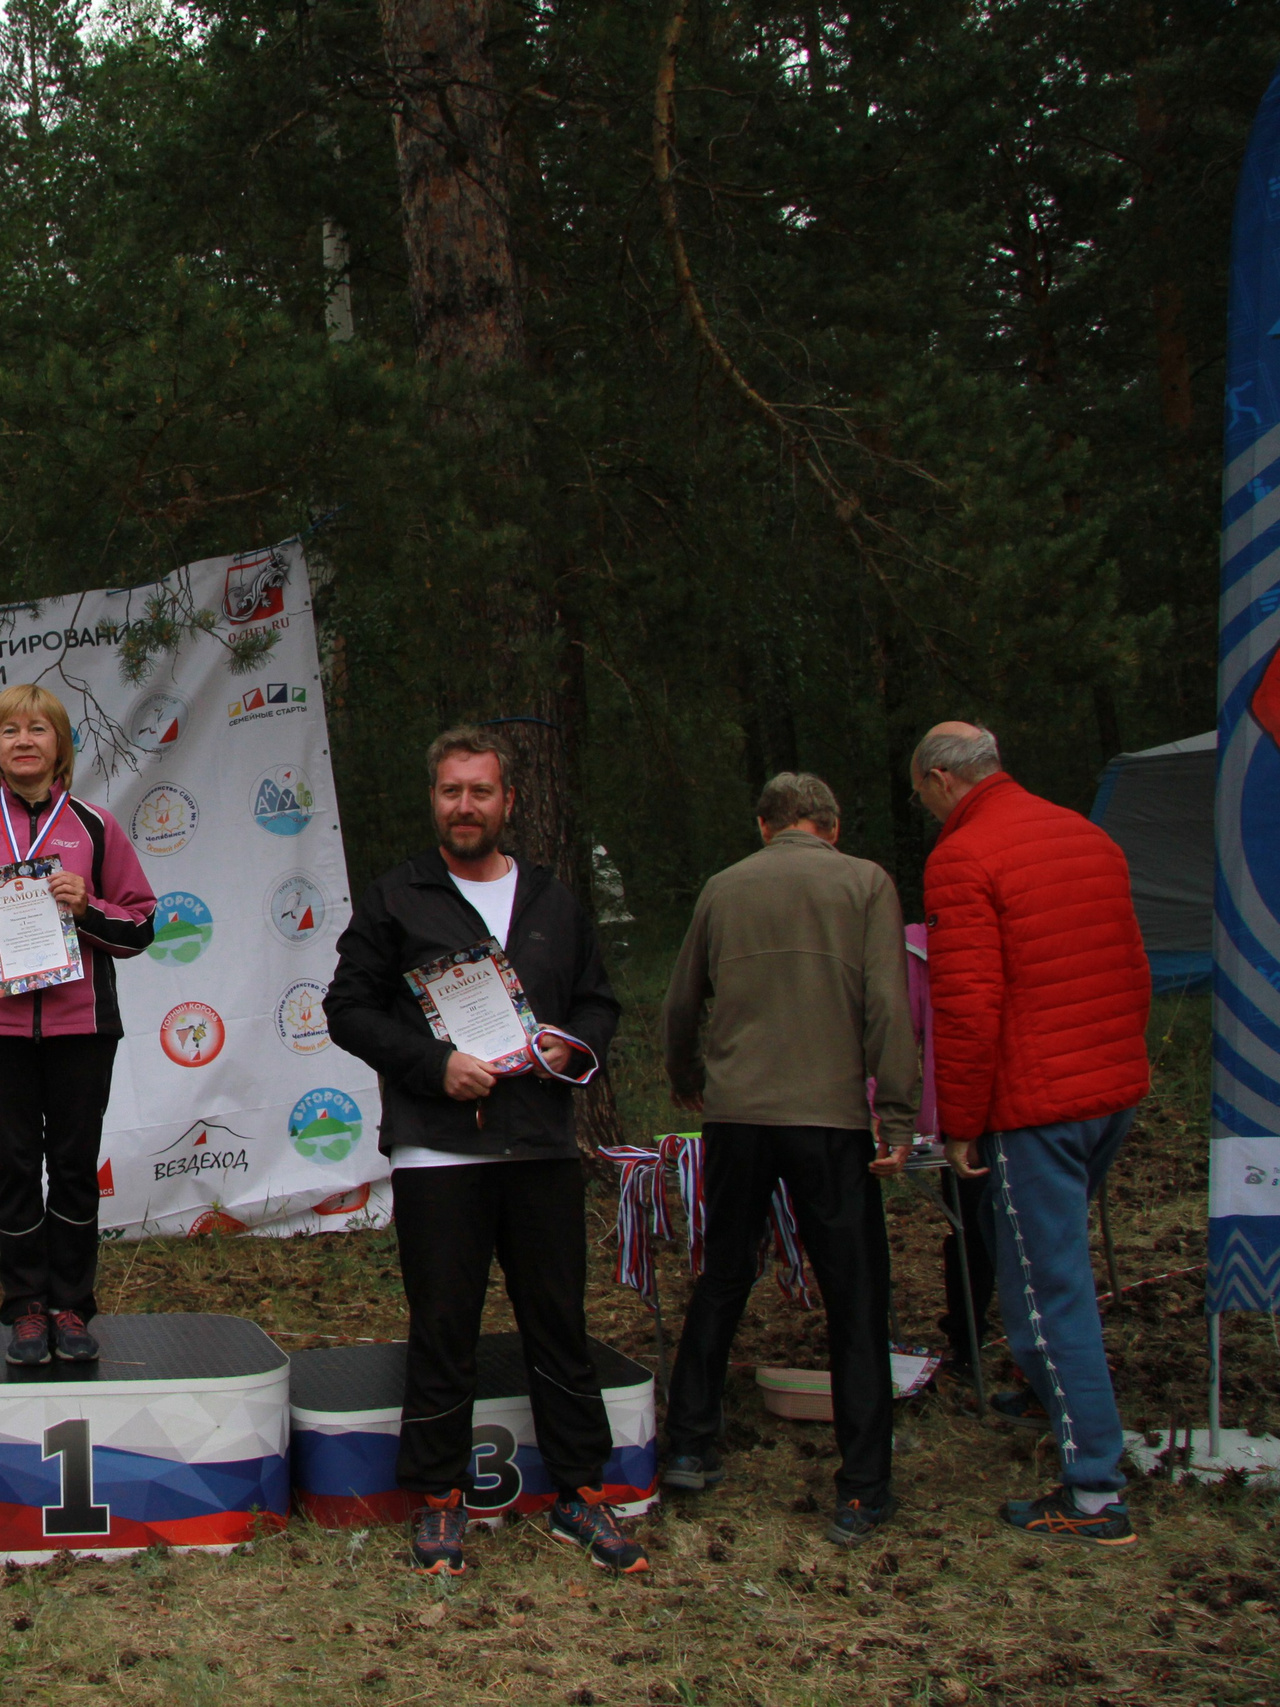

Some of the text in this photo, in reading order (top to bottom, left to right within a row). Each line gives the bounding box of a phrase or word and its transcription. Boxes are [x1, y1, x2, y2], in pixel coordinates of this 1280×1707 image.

[229, 705, 308, 727] СЕМЕЙНЫЕ СТАРТЫ
[179, 790, 196, 810] СШОР
[145, 830, 186, 842] Челябинск
[156, 894, 204, 917] ГОРОК
[436, 969, 491, 997] ГРАМОТА
[162, 1003, 219, 1031] ГОРНЫЙ КОРОЛЬ
[153, 1148, 249, 1181] ВЕЗДЕХОД
[41, 1418, 110, 1536] 1
[463, 1423, 522, 1510] 3
